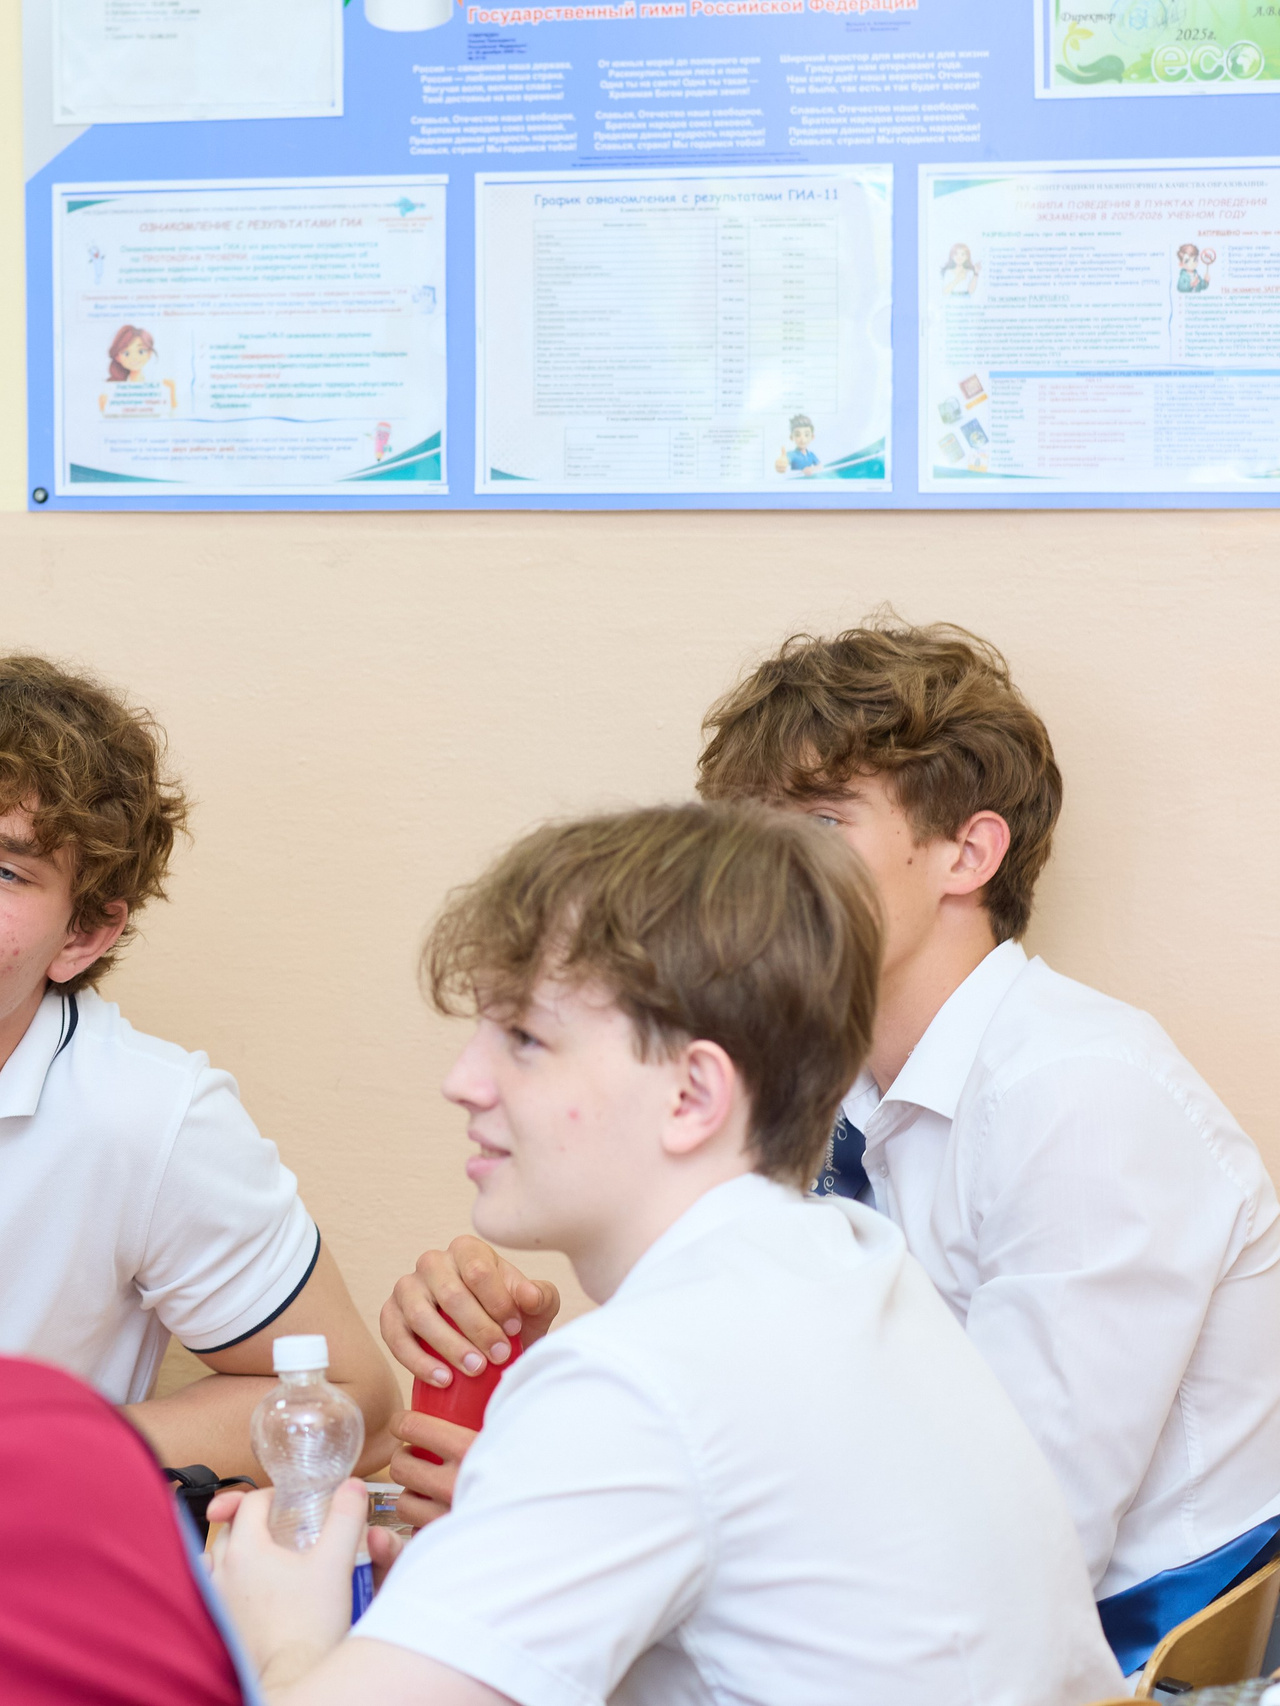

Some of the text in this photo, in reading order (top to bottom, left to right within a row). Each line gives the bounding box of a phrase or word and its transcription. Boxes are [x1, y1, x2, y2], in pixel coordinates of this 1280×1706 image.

[468, 0, 918, 25] Государственный гимн Российской Федерации
[1061, 12, 1116, 24] Директор
[534, 193, 582, 208] График
[586, 193, 677, 206] ознакомления
[694, 192, 782, 206] результатами
[788, 188, 838, 201] ГИА-11
[1067, 200, 1131, 210] ПОВЕДЕНИЯ
[1144, 199, 1194, 209] ПУНКТАХ
[1198, 197, 1268, 208] ПРОВЕДЕНИЯ
[1167, 210, 1215, 220] УЧЕБНОМ
[1219, 210, 1247, 219] ГОДУ
[139, 220, 232, 233] ОЗНАКОМЛЕНИЕ
[247, 218, 337, 230] РЕЗУЛЬТАТАМИ
[340, 217, 363, 228] ГИА
